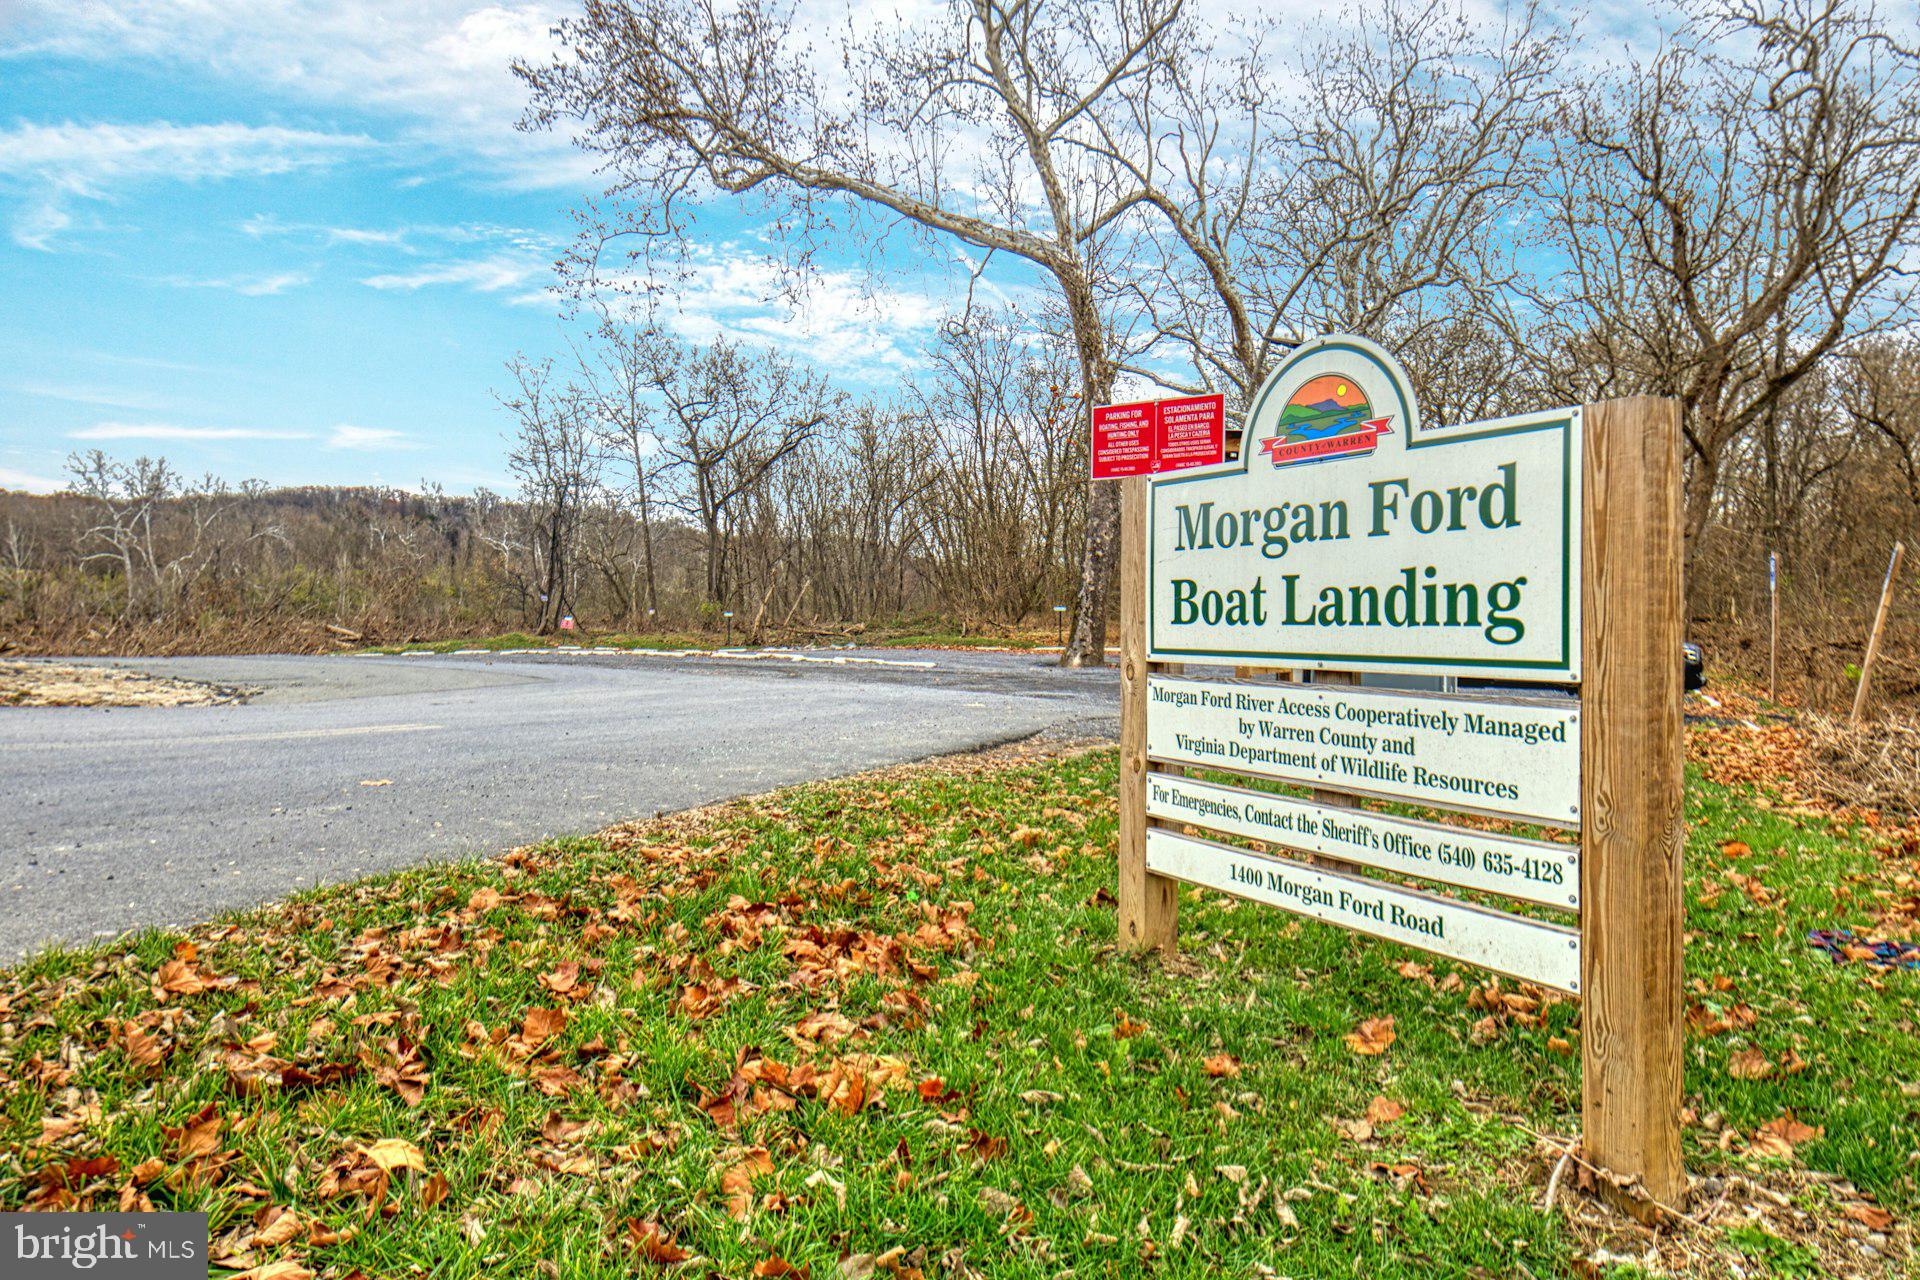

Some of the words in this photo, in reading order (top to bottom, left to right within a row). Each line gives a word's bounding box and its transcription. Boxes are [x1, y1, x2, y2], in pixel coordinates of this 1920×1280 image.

[1105, 411, 1130, 421] PARKING
[1131, 409, 1142, 418] FOR
[1163, 402, 1216, 415] ESTACIONAMIENTO
[1199, 411, 1215, 421] PARA
[1139, 419, 1149, 428] AND
[1174, 424, 1187, 432] PASEO
[1107, 431, 1127, 440] HUNTING
[1128, 430, 1139, 438] ONLY
[1174, 431, 1188, 439] PESCA
[1098, 448, 1122, 456] CONSIDERED
[1122, 446, 1149, 454] TRESPASSING
[1279, 442, 1322, 456] COUNTY
[1327, 435, 1372, 449] WARREN
[1121, 453, 1149, 461] PROSECUTION
[1174, 500, 1350, 560] Morgan
[1367, 462, 1521, 538] Ford
[1170, 576, 1267, 626] Boat
[1281, 566, 1528, 645] Landing
[1152, 686, 1198, 708] Morgan
[1201, 690, 1232, 709] Ford
[1235, 693, 1274, 713] River
[1278, 698, 1330, 718] Access
[1335, 701, 1459, 736] Cooperatively
[1464, 712, 1566, 745] Managed
[1238, 717, 1255, 738] by
[1258, 720, 1315, 743] Warren
[1319, 727, 1378, 754] County
[1382, 736, 1416, 756] and
[1175, 733, 1225, 756] Virginia
[1228, 741, 1317, 769] Department
[1321, 754, 1338, 771] of
[1340, 755, 1408, 783] Wildlife
[1412, 766, 1519, 800] Resources
[1152, 785, 1169, 803] For
[1172, 788, 1242, 823] Emergencies,
[1244, 804, 1294, 831] Contact
[1297, 813, 1318, 836] the
[1322, 817, 1379, 850] Sheriff's
[1383, 831, 1432, 860] Office
[1438, 842, 1475, 870] (540)
[1483, 851, 1564, 885] 635-4128
[1230, 863, 1263, 887] 1400
[1267, 871, 1333, 907] Morgan
[1338, 890, 1385, 921] Ford
[1389, 903, 1444, 939] Road
